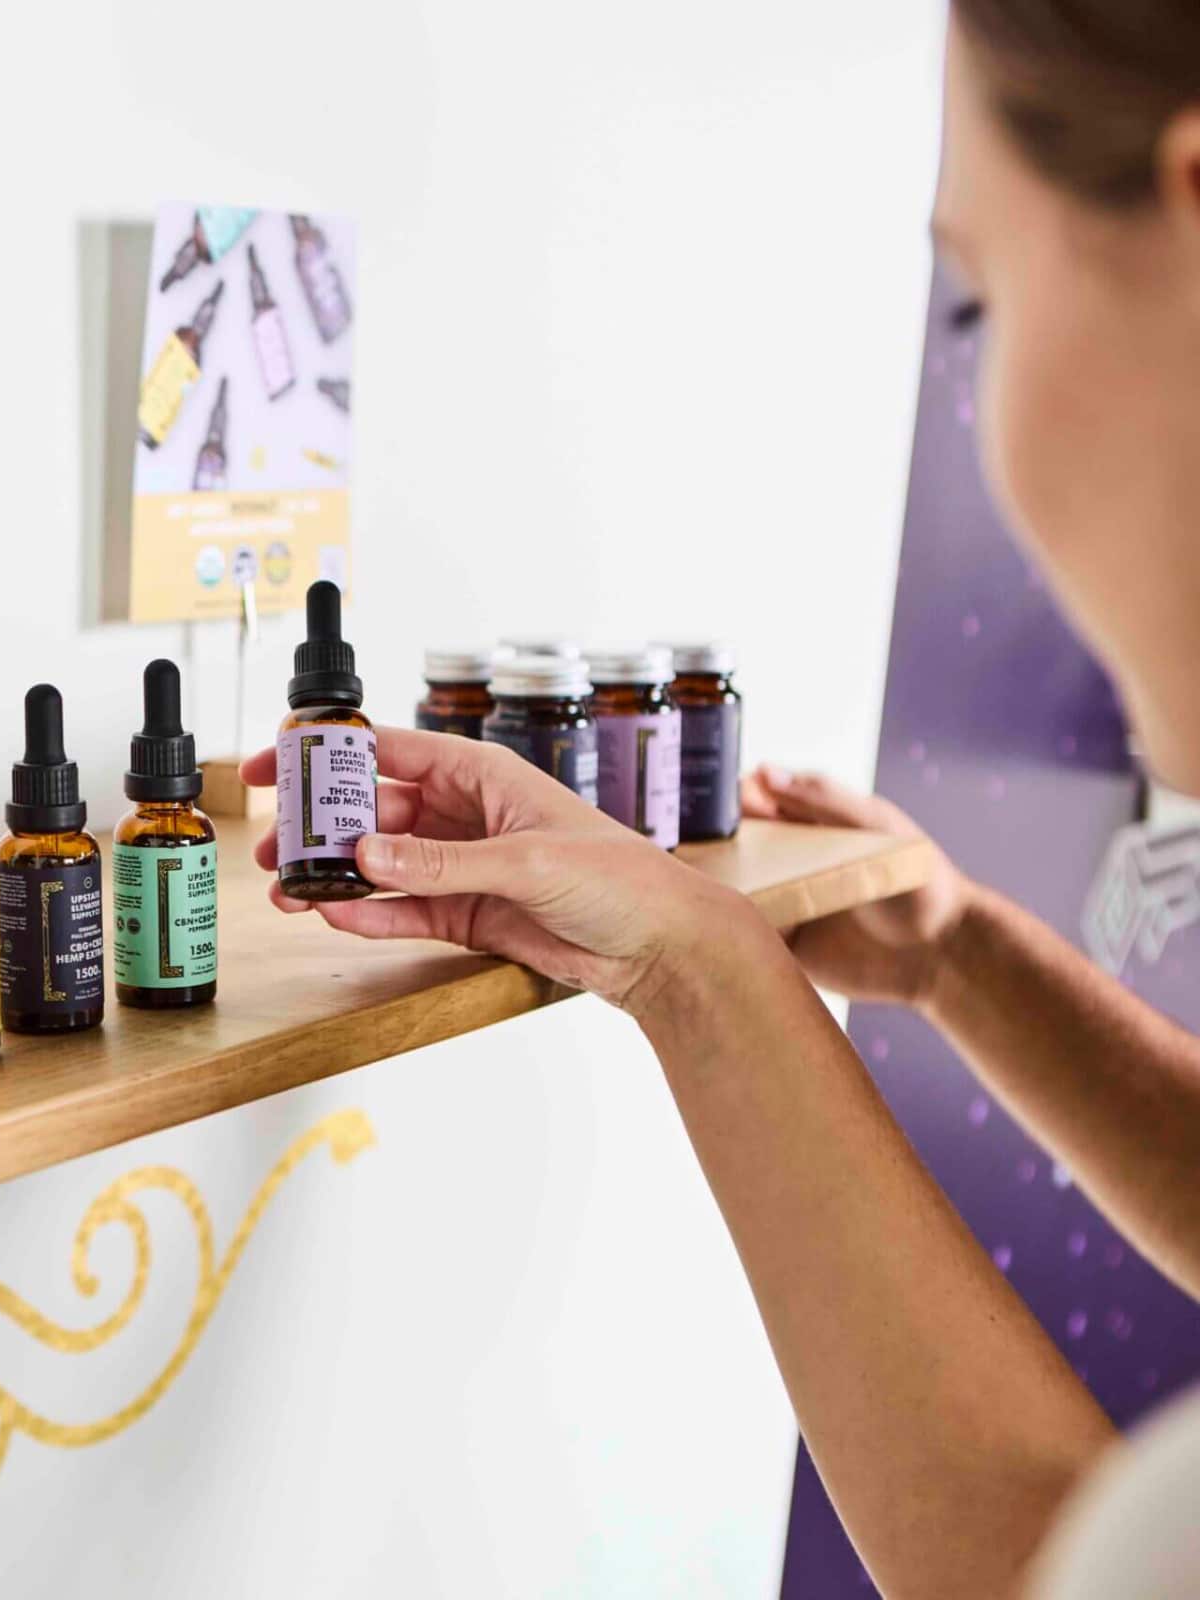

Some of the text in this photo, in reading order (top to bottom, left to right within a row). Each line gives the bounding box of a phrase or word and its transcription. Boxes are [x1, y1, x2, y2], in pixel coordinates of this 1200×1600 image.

[330, 749, 366, 760] UPSTATE
[330, 758, 366, 768] ELEVATOR
[328, 787, 369, 800] THC FREE
[319, 796, 341, 806] CBD
[343, 797, 362, 807] MCT
[56, 952, 84, 964] HEMP
